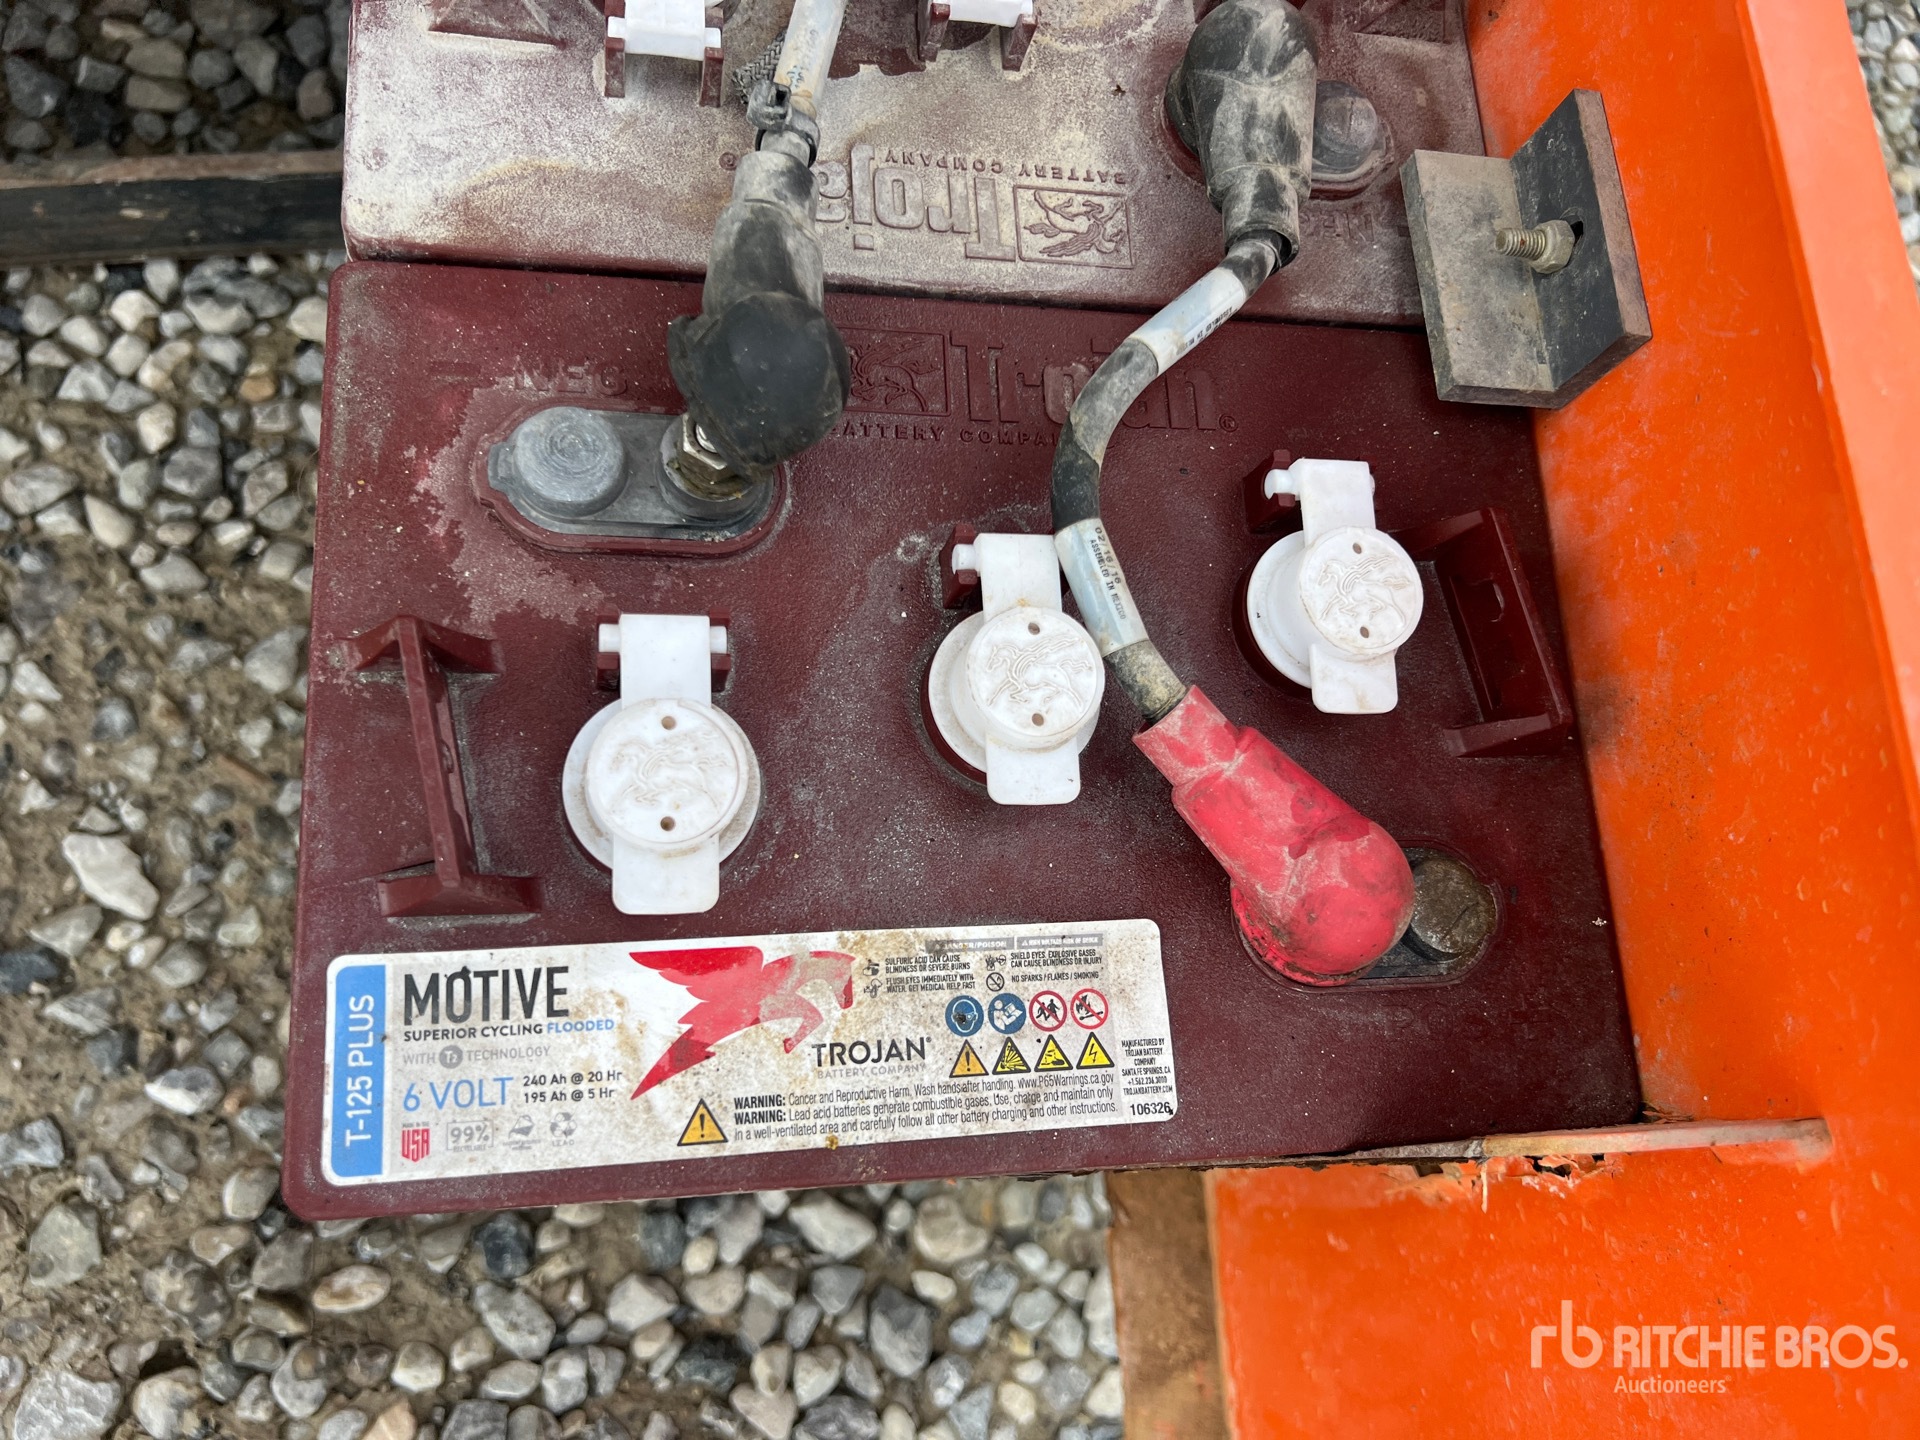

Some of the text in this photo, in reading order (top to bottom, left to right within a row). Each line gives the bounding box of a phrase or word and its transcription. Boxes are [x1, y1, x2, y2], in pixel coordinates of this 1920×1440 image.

[884, 148, 1003, 174] COMPANY
[815, 144, 1016, 262] Troja
[829, 421, 943, 441] ATTERY
[885, 954, 960, 966] SULFURIC ACID CAN CAUSE
[1011, 951, 1030, 960] SHIELD
[1048, 949, 1077, 959] EXPLOSIVE
[1078, 948, 1096, 957] GASES
[1011, 956, 1102, 968] CAN CAUSE BLINDNESS OR INJURY
[885, 962, 970, 974] BLINDNESS OR SEVERE BURNS
[1011, 975, 1019, 983] NO
[1021, 974, 1042, 982] SPARKS
[1048, 973, 1069, 981] FLAMES
[1074, 971, 1099, 980] SMOKING
[886, 973, 974, 986] FLUSH EYES IMMEDIATELY WITH
[908, 984, 919, 992] GET
[921, 983, 945, 992] MEDICAL
[947, 982, 961, 990] HELP
[963, 981, 975, 989] FAST
[404, 966, 569, 1026] MOTIVE
[404, 1019, 615, 1042] SUPERIOR CYCLING FLOODED
[811, 1036, 926, 1067] TROJAN
[1121, 1038, 1158, 1047] MANUFACTURED
[1125, 1048, 1163, 1057] TROJAN BATTERY
[403, 1051, 436, 1065] WITH
[467, 1045, 551, 1062] TECHNOLOGY
[345, 995, 374, 1148] T-125 PLUS
[523, 1069, 623, 1087] 240 Ah @ 20 Hr
[817, 1062, 927, 1079] BATTERY COMPANY
[403, 1077, 514, 1112] 6 VOLT
[524, 1087, 615, 1103] 195 Ah @ 5 Hr
[734, 1072, 1115, 1110] WARNING: Cancer and Reproductive Harm. Wash hands after handling. www.P65Warnings.ca.gov
[734, 1109, 786, 1125] WARNING:
[789, 1107, 811, 1121] Lead
[813, 1105, 832, 1119] acid
[834, 1102, 871, 1118] batteries
[873, 1101, 910, 1117] generate
[912, 1093, 962, 1112] combustible
[964, 1095, 992, 1109] gases.
[1013, 1091, 1041, 1105] charge
[1043, 1090, 1059, 1102] and
[1060, 1087, 1095, 1101] maintain
[1097, 1086, 1114, 1101] only
[1130, 1102, 1171, 1115] 106326
[746, 1131, 751, 1140] a
[754, 1122, 817, 1140] well-ventilated
[819, 1122, 839, 1134] area
[841, 1120, 857, 1132] and
[860, 1114, 896, 1131] carefully
[898, 1113, 923, 1128] follow
[925, 1113, 935, 1126] all
[937, 1110, 957, 1125] other
[961, 1109, 989, 1125] battery
[991, 1106, 1027, 1122] charging
[1029, 1105, 1044, 1118] and
[1046, 1104, 1067, 1117] other
[1070, 1100, 1118, 1115] instructions.
[451, 1122, 490, 1144] 99%
[402, 1128, 430, 1163] USA
